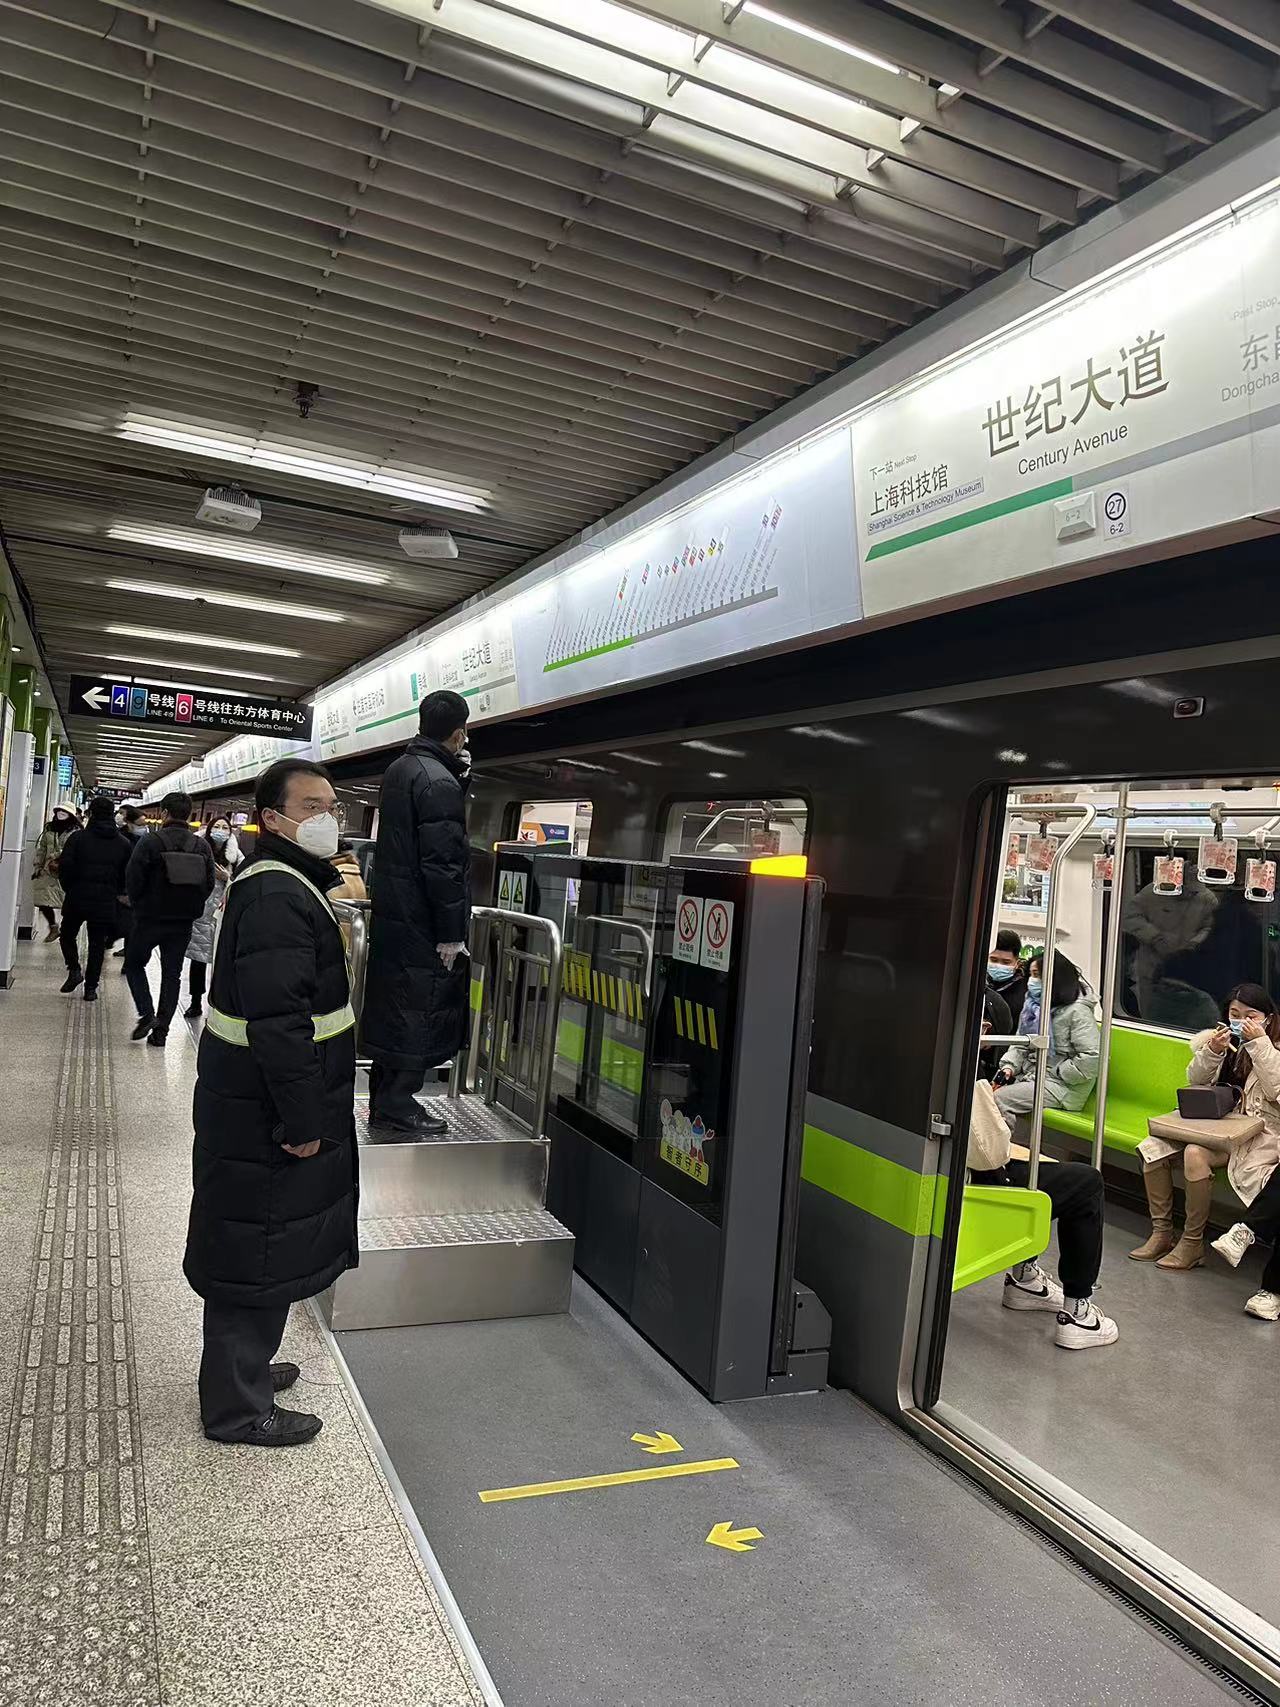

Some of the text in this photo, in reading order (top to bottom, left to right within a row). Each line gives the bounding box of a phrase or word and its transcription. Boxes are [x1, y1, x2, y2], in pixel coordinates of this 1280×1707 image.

[1256, 296, 1278, 312] Stop
[981, 329, 1170, 458] 世纪大道
[1018, 423, 1128, 475] Century Avenue
[869, 461, 894, 480] 下一站
[870, 463, 948, 516] 上海科技馆
[869, 480, 982, 531] Shanghai Science & Technology Museum
[1108, 498, 1122, 515] 27
[1065, 510, 1081, 522] 6-2
[1109, 522, 1124, 535] 6-2
[114, 693, 306, 724] 4 9 号线 6 号线往东方体育中心
[147, 709, 162, 717] LINE
[192, 714, 208, 722] LINE
[228, 718, 252, 728] Oriental
[253, 721, 272, 731] Sports
[273, 723, 293, 733] Center
